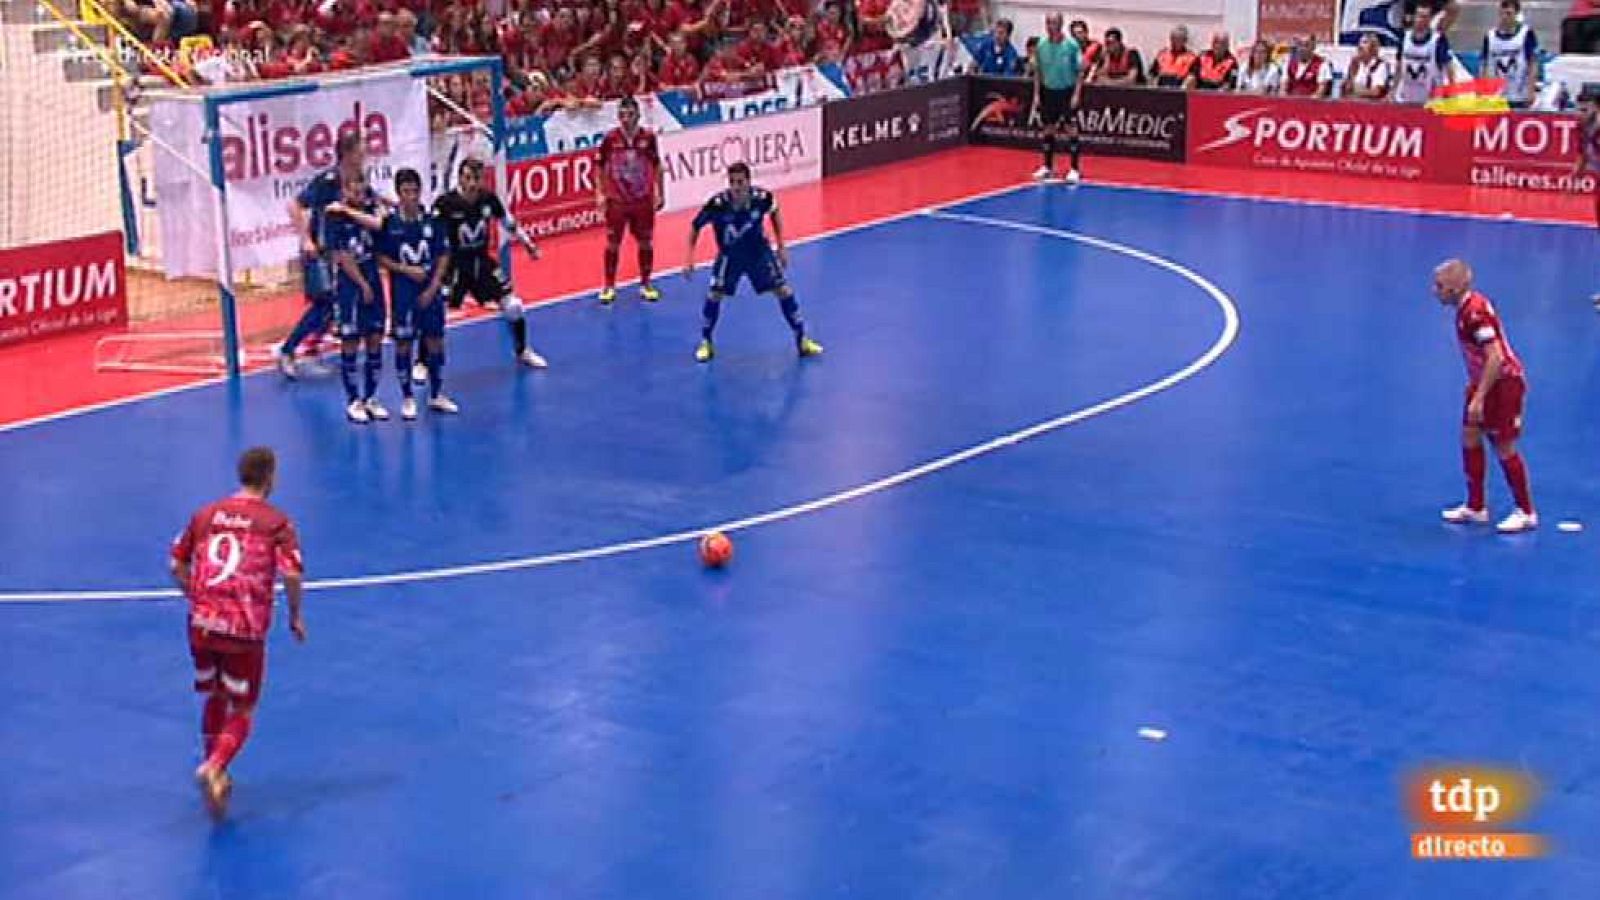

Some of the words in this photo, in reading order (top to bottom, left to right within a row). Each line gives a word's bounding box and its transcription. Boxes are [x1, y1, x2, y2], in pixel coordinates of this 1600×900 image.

[832, 117, 902, 150] KELME
[1199, 106, 1423, 158] SPORTIUM
[206, 533, 240, 586] 9
